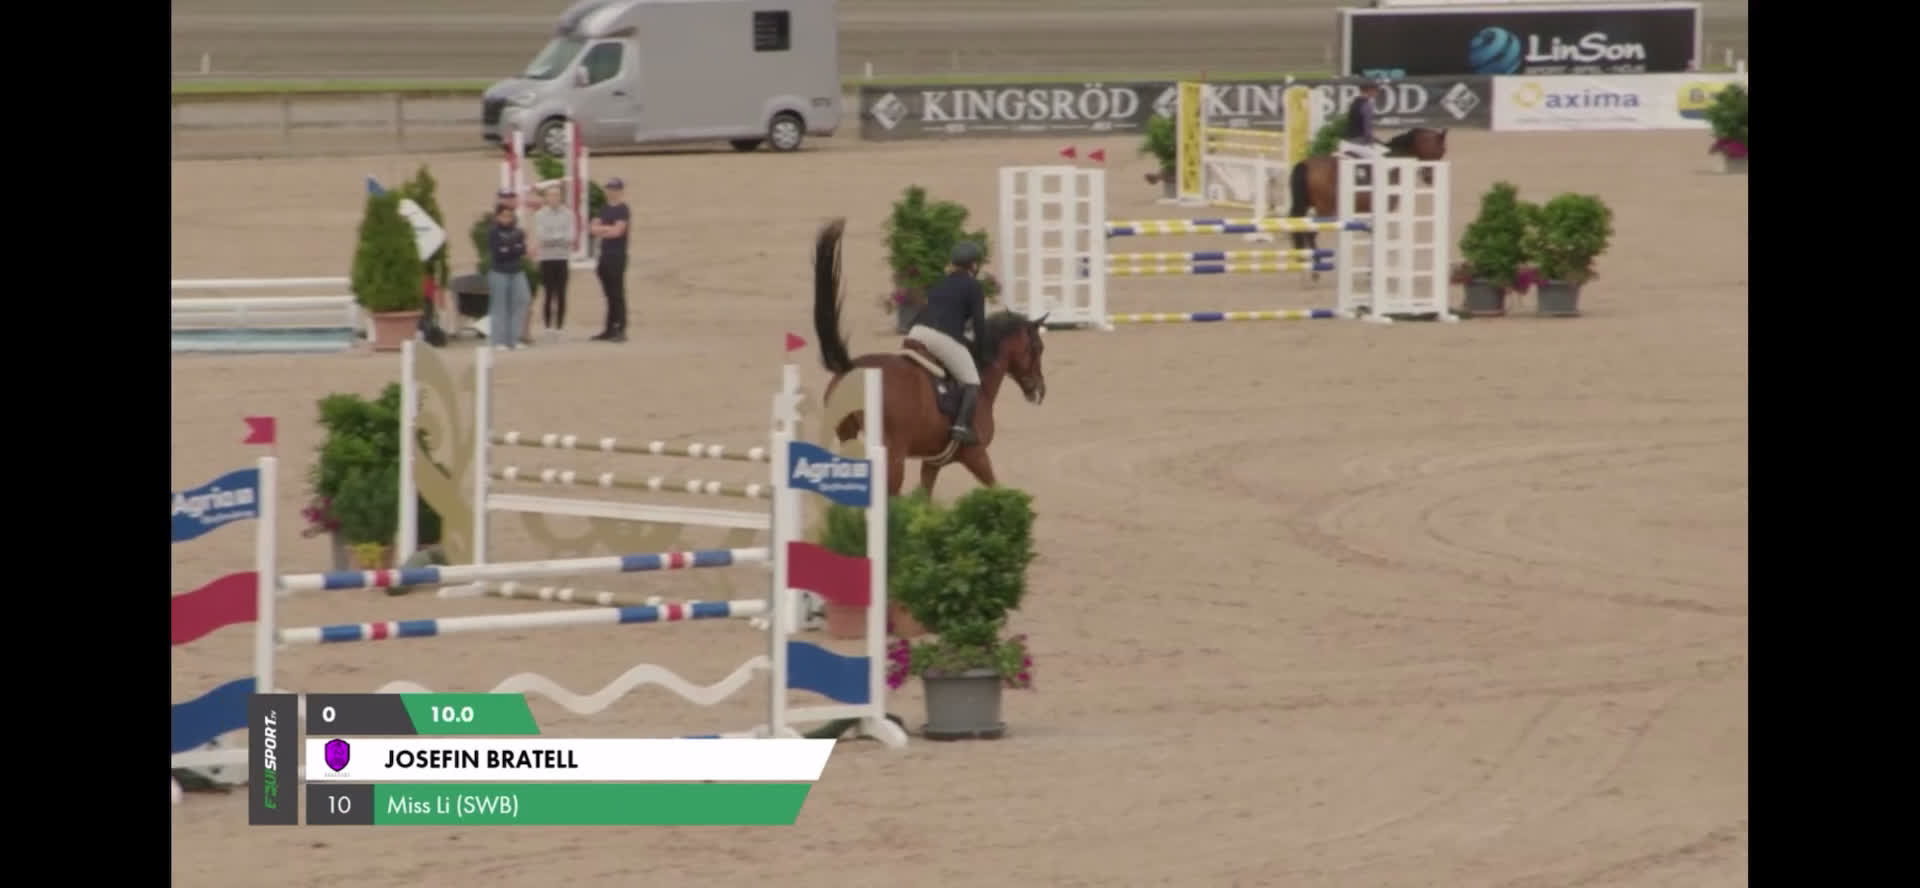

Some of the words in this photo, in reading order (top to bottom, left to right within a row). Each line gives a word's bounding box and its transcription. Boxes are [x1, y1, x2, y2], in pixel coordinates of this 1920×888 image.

[1525, 32, 1646, 62] LinSon
[921, 83, 1139, 121] KINGSRÖD
[1545, 88, 1640, 109] axima
